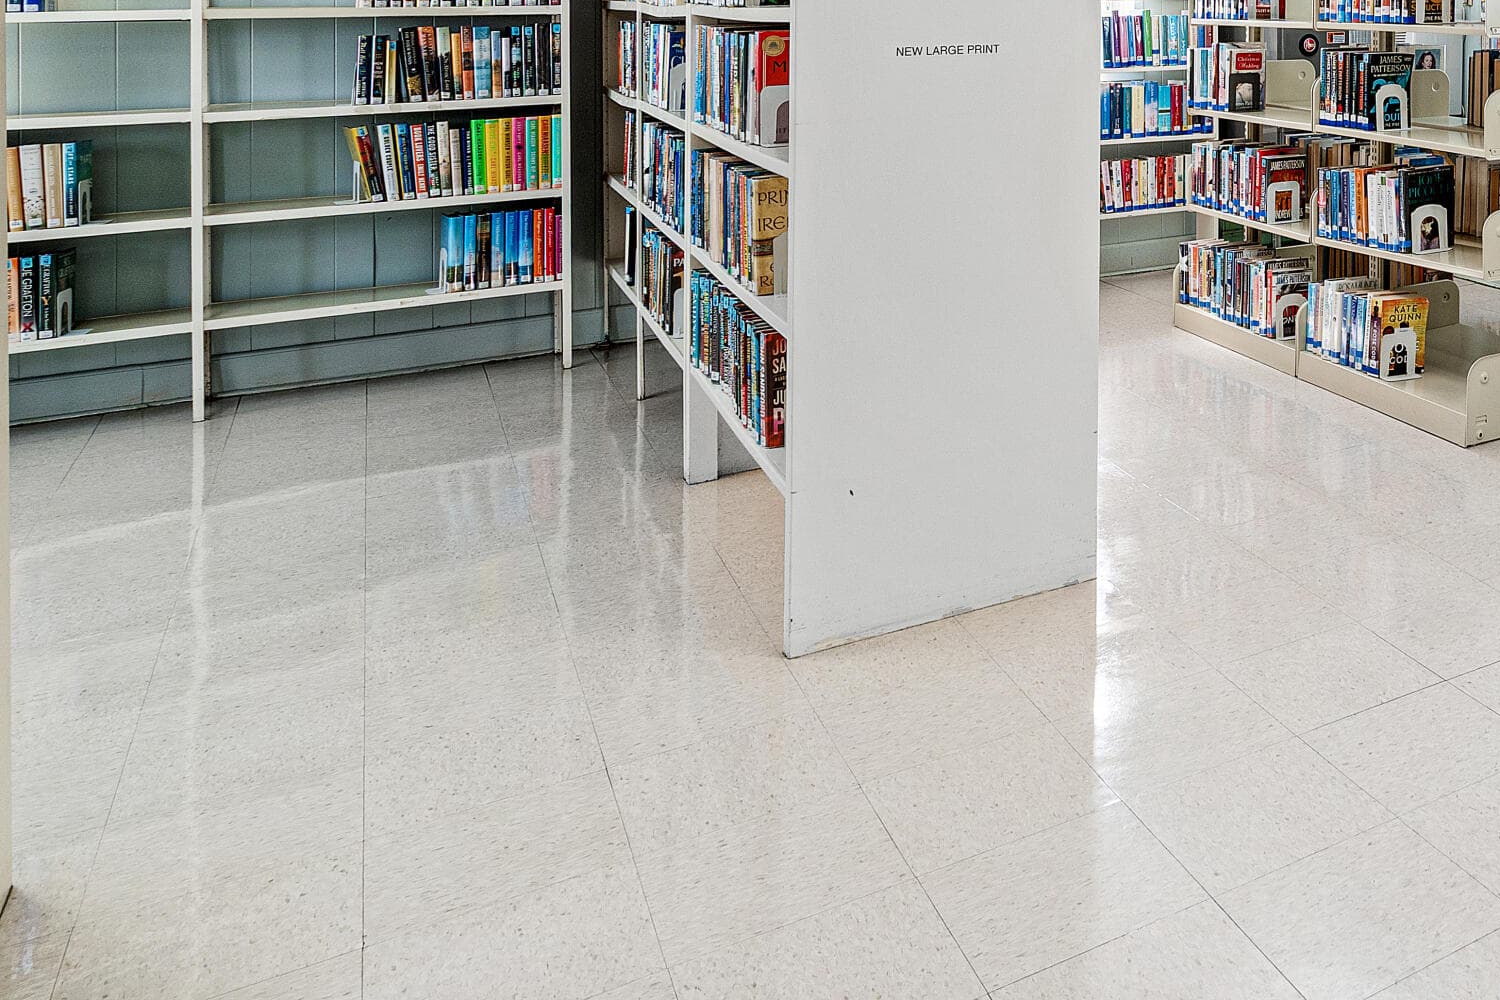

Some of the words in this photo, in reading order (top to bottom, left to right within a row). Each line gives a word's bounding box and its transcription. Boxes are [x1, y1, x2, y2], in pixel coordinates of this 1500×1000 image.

[896, 47, 922, 56] NEW
[926, 46, 964, 55] LARGE
[967, 44, 999, 54] PRINT
[1380, 56, 1402, 64] JAMES
[1370, 65, 1410, 73] PATTERSON
[428, 137, 436, 152] GOOD
[429, 154, 438, 170] SISTER
[22, 279, 33, 317] GRAFTON
[1394, 305, 1417, 313] KATE
[1389, 313, 1421, 322] QUINN
